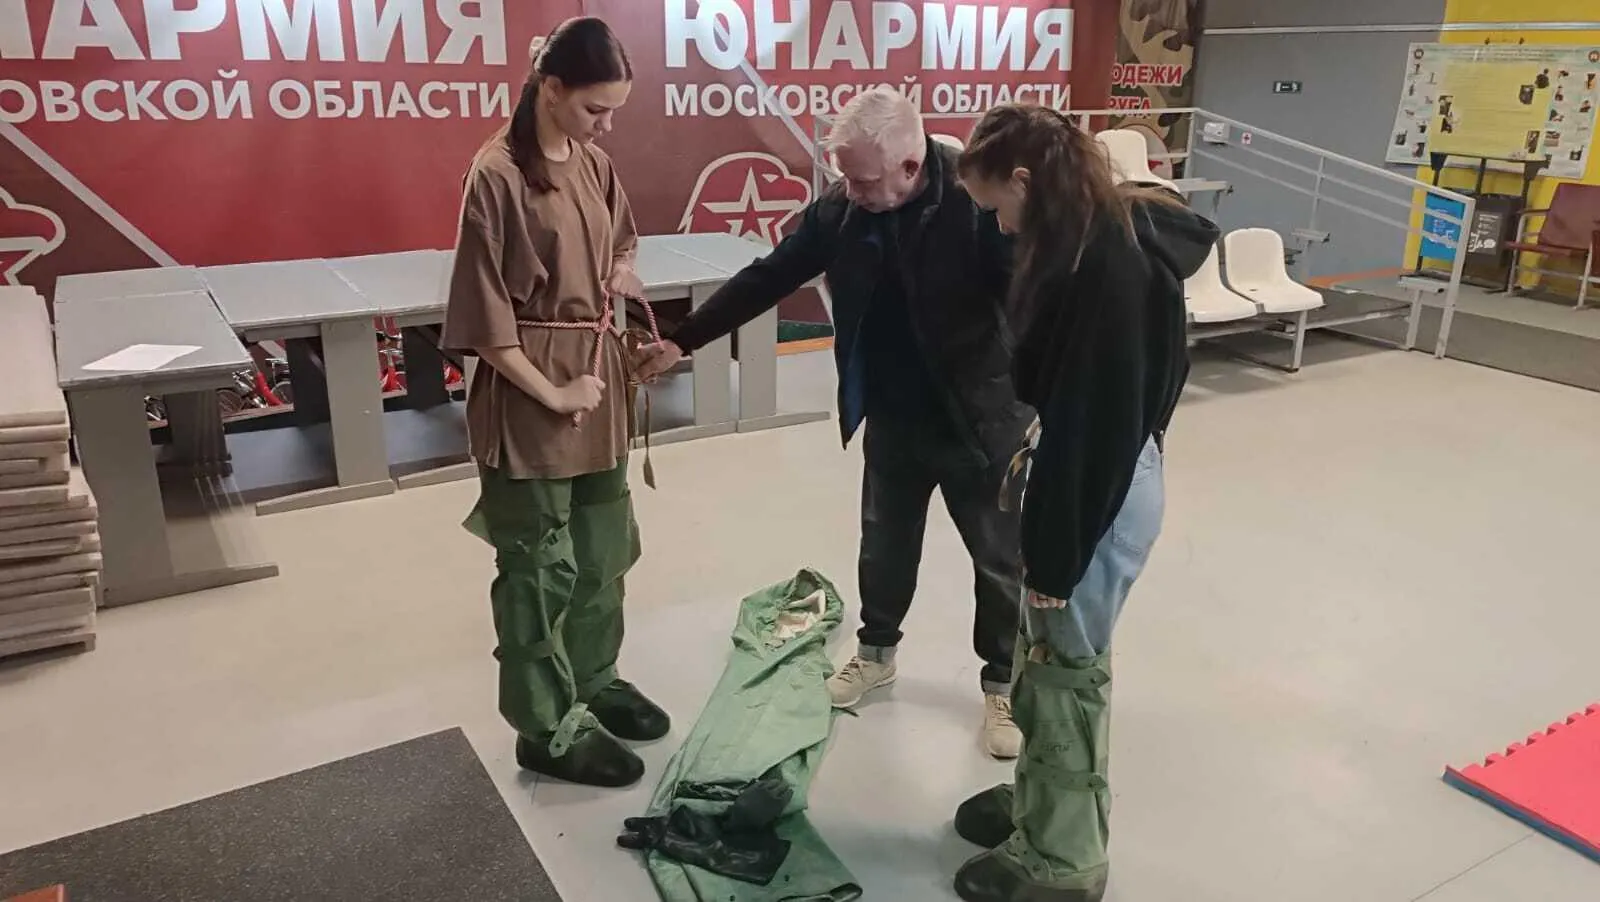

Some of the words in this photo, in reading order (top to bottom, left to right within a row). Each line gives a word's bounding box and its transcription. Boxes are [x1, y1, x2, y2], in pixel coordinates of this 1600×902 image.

[664, 0, 1073, 71] ЮНАРМИЯ
[268, 79, 511, 119] ОБЛАСТИ
[665, 75, 922, 117] МОСКОВСЙ
[932, 83, 1072, 113] ОБЛАСТИ
